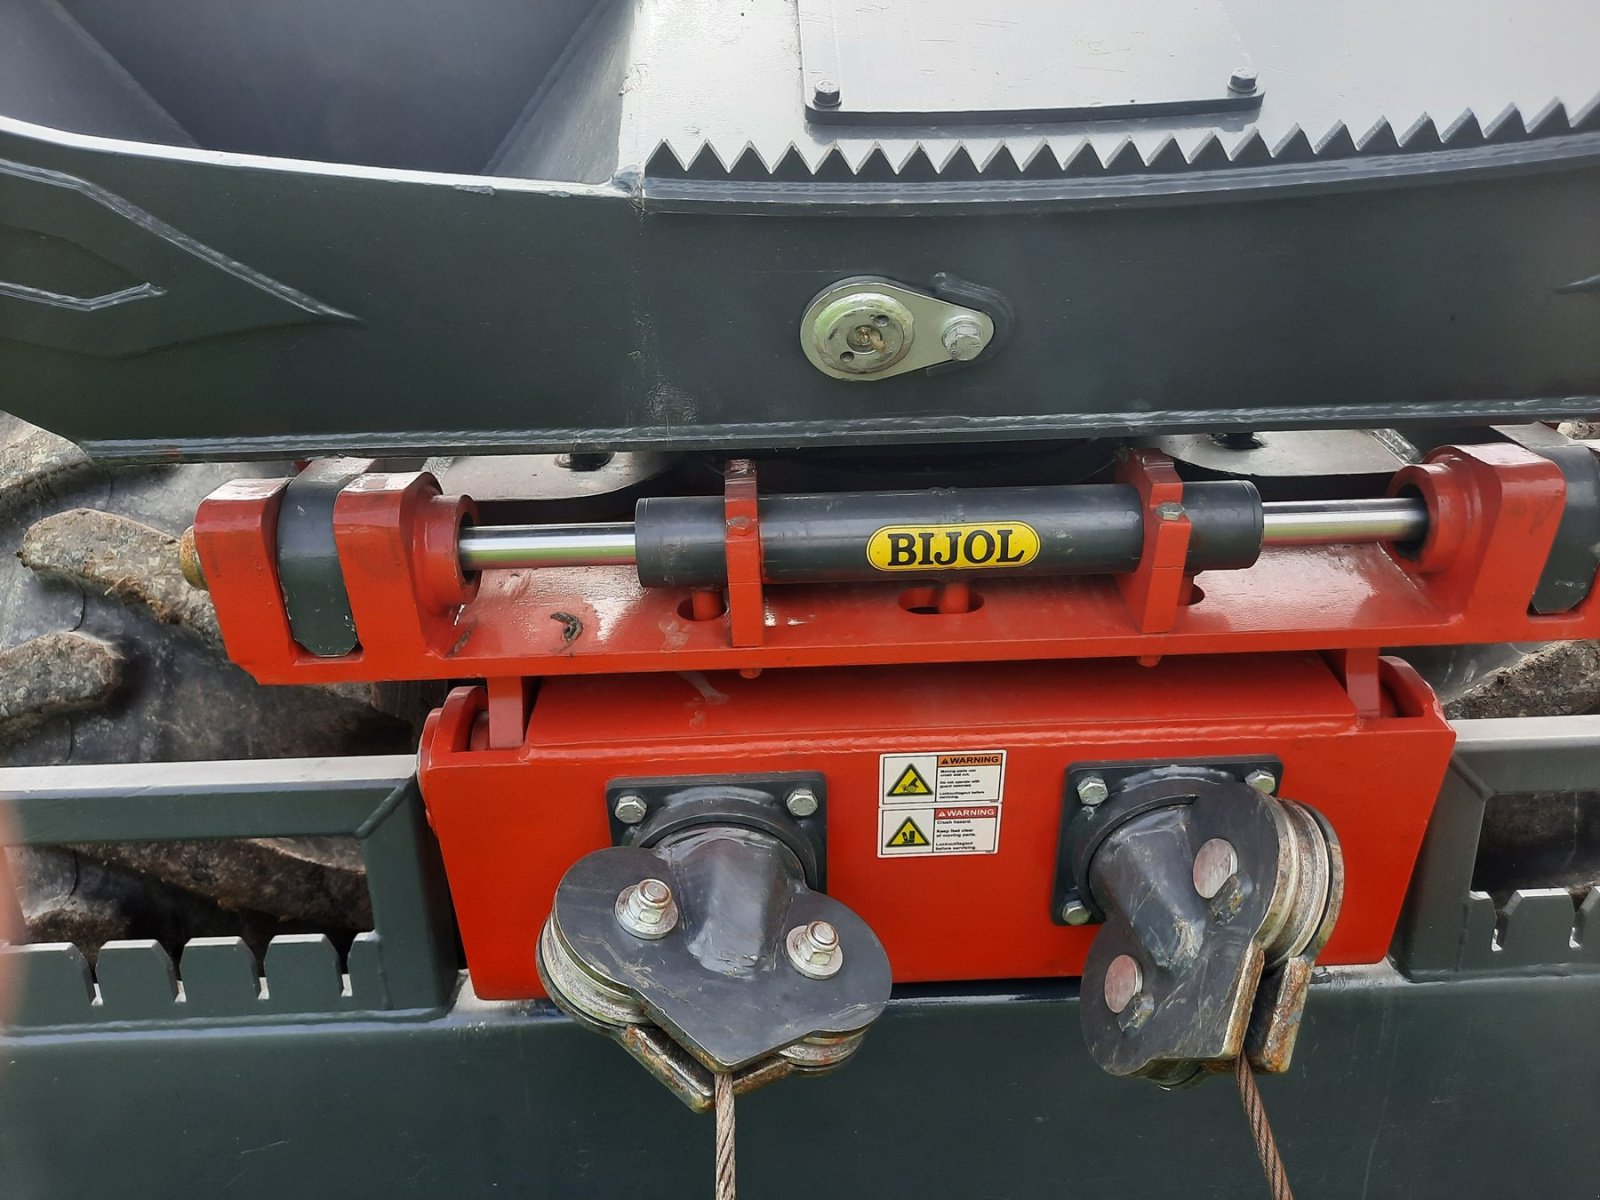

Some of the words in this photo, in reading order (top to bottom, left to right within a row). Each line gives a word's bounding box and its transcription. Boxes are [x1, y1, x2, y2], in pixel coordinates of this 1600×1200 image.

[887, 529, 1025, 566] BIJOL
[950, 756, 999, 764] WARNING
[946, 808, 995, 817] WARNING
